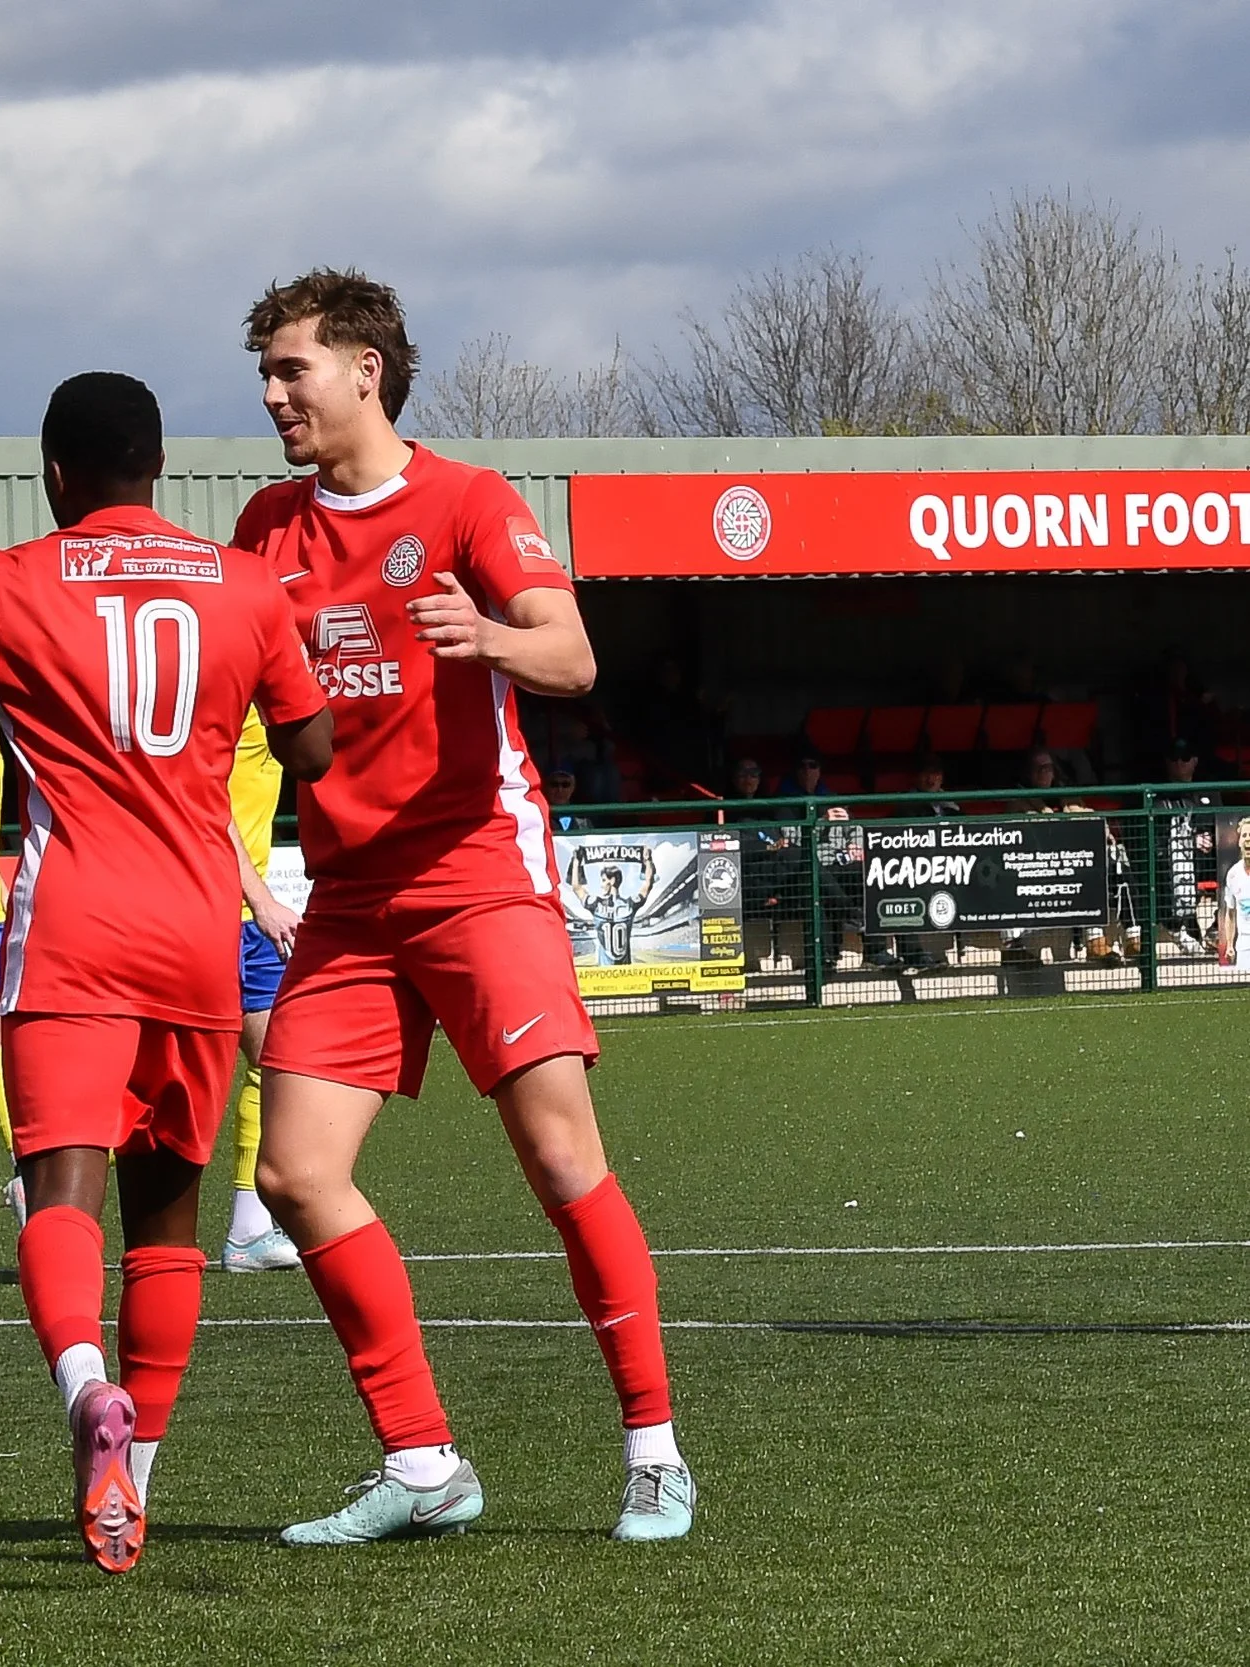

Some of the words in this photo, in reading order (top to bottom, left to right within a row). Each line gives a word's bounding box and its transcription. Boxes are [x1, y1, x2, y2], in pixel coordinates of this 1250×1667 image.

[909, 493, 1110, 560] QUORN
[92, 538, 132, 551] Fencing
[133, 540, 142, 549] &
[144, 538, 213, 554] Groundworks
[95, 595, 200, 757] 10
[585, 846, 619, 860] HAPPY
[620, 846, 641, 860] DOG
[867, 828, 937, 850] Football
[941, 825, 1023, 847] Education
[866, 854, 977, 890] ACADEMY
[602, 922, 627, 956] 10
